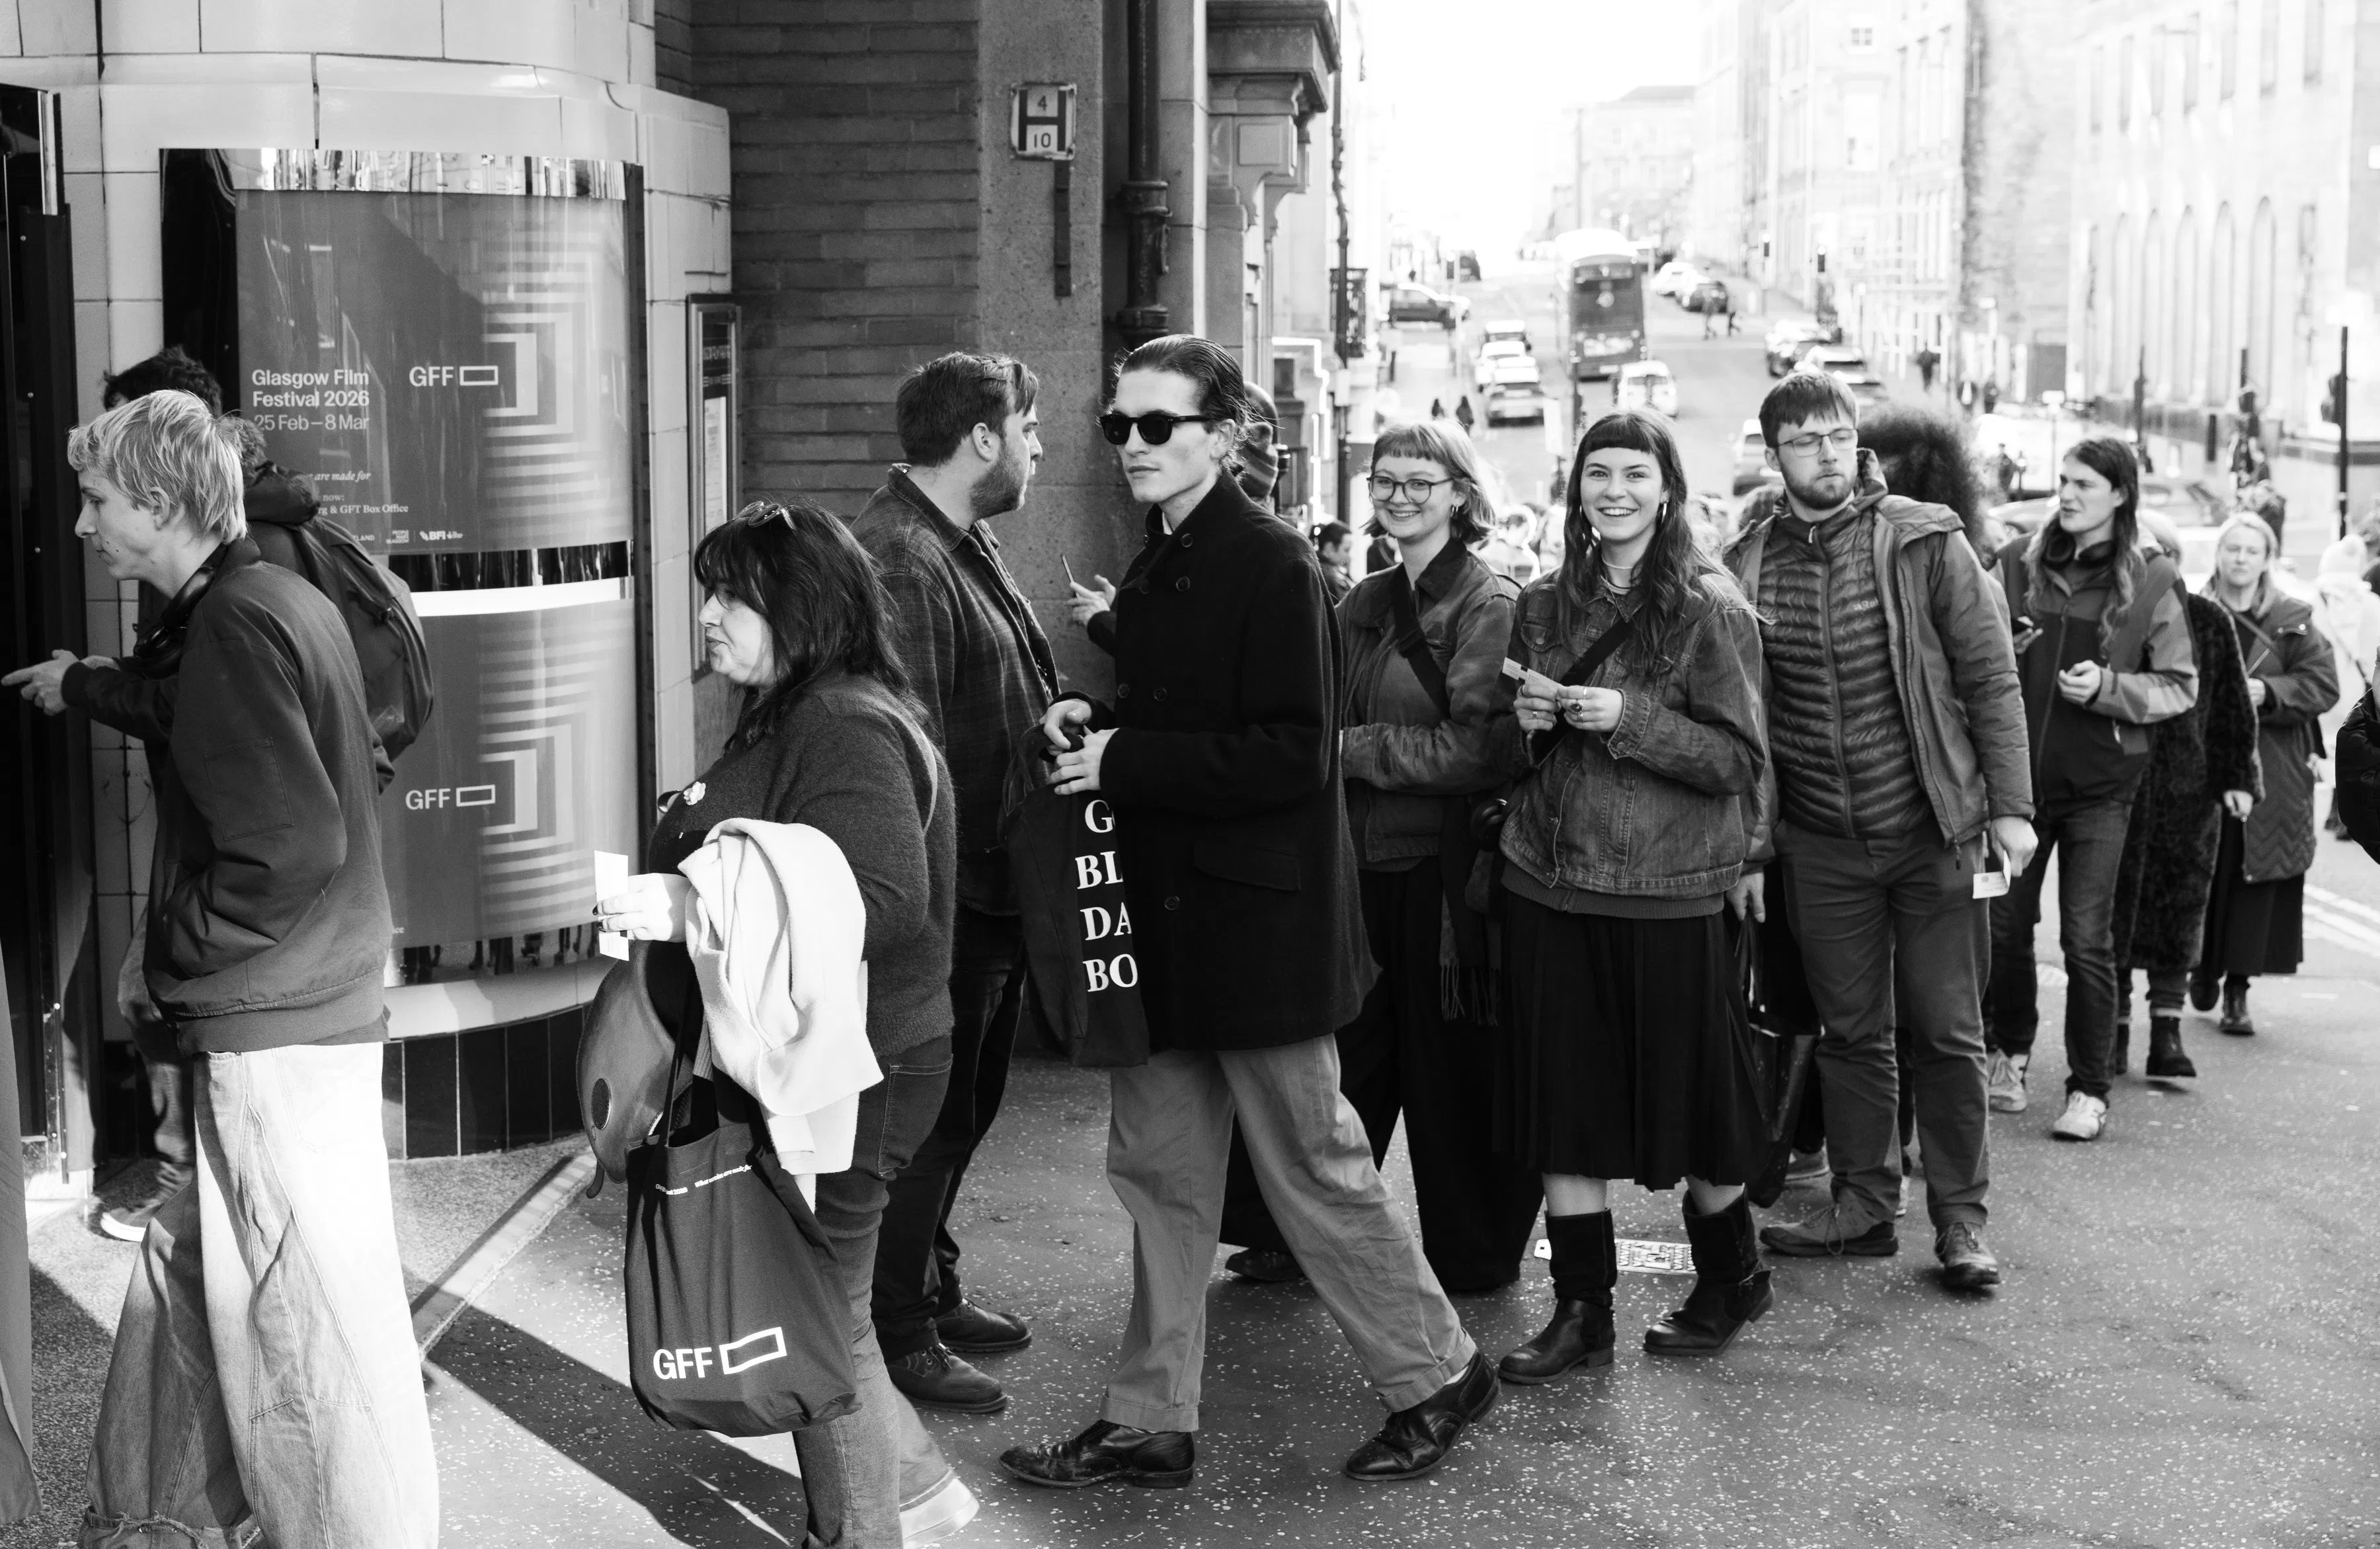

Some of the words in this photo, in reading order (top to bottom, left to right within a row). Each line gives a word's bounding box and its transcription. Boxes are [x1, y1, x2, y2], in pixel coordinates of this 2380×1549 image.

[1037, 95, 1047, 112] 4
[1033, 132, 1051, 148] 10
[252, 369, 329, 389] Glasgow
[333, 369, 369, 385] Film
[409, 366, 454, 387] GFF
[253, 390, 320, 407] Festival
[323, 390, 370, 407] 2026
[253, 414, 275, 431] 25
[338, 413, 370, 430] Mar
[332, 470, 356, 481] made
[355, 470, 372, 483] for
[330, 504, 338, 514] &
[340, 504, 362, 514] GFT
[363, 504, 381, 514] Box
[381, 503, 409, 514] Office
[405, 787, 451, 811] GFF
[653, 1347, 713, 1380] GFF
